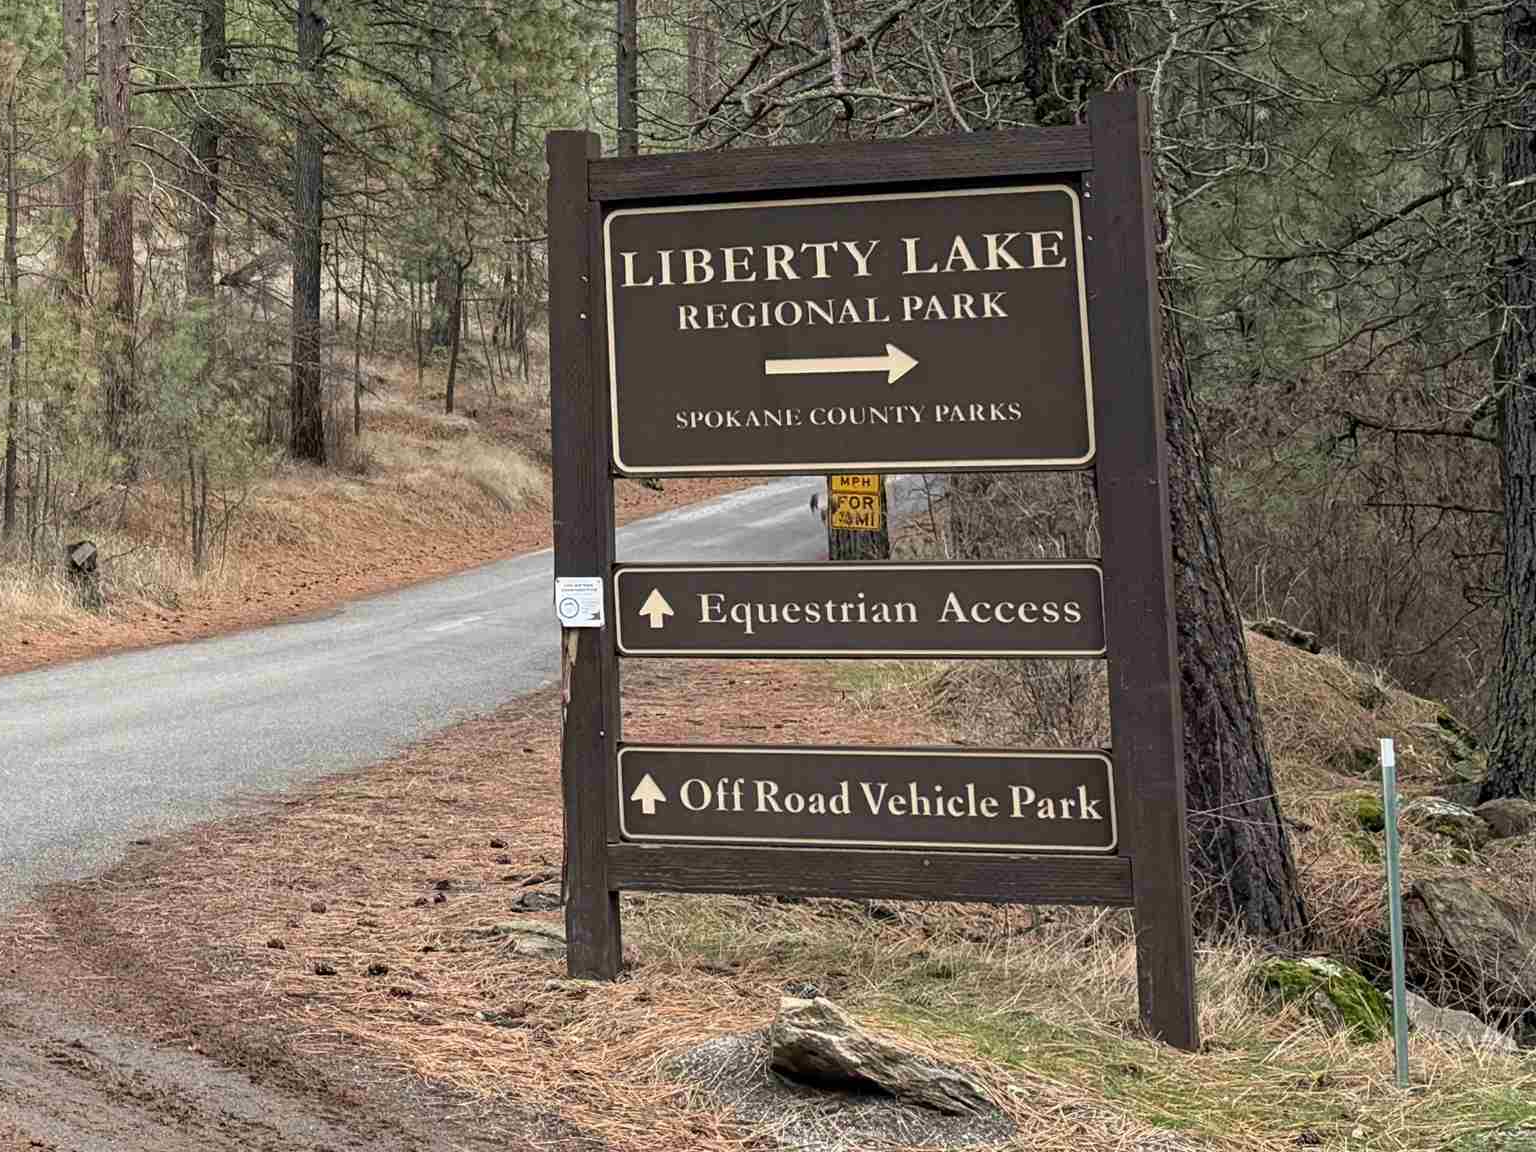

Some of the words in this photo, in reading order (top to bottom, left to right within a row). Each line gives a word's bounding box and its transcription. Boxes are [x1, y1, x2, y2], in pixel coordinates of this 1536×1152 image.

[620, 239, 881, 288] LIBERTY
[902, 230, 1067, 275] LAKE
[678, 297, 889, 330] REGIONAL
[903, 291, 1009, 321] PARK
[675, 408, 802, 429] SPOKANE
[809, 405, 925, 426] COUNTY
[935, 403, 1023, 423] PARKS
[840, 476, 871, 487] MPH
[838, 495, 874, 510] FOR
[698, 592, 918, 634] Equestrian
[938, 592, 1082, 624] Access
[679, 778, 745, 812] Off
[754, 780, 851, 815] Road
[860, 782, 999, 818] Vehicle
[1009, 784, 1103, 820] Park
